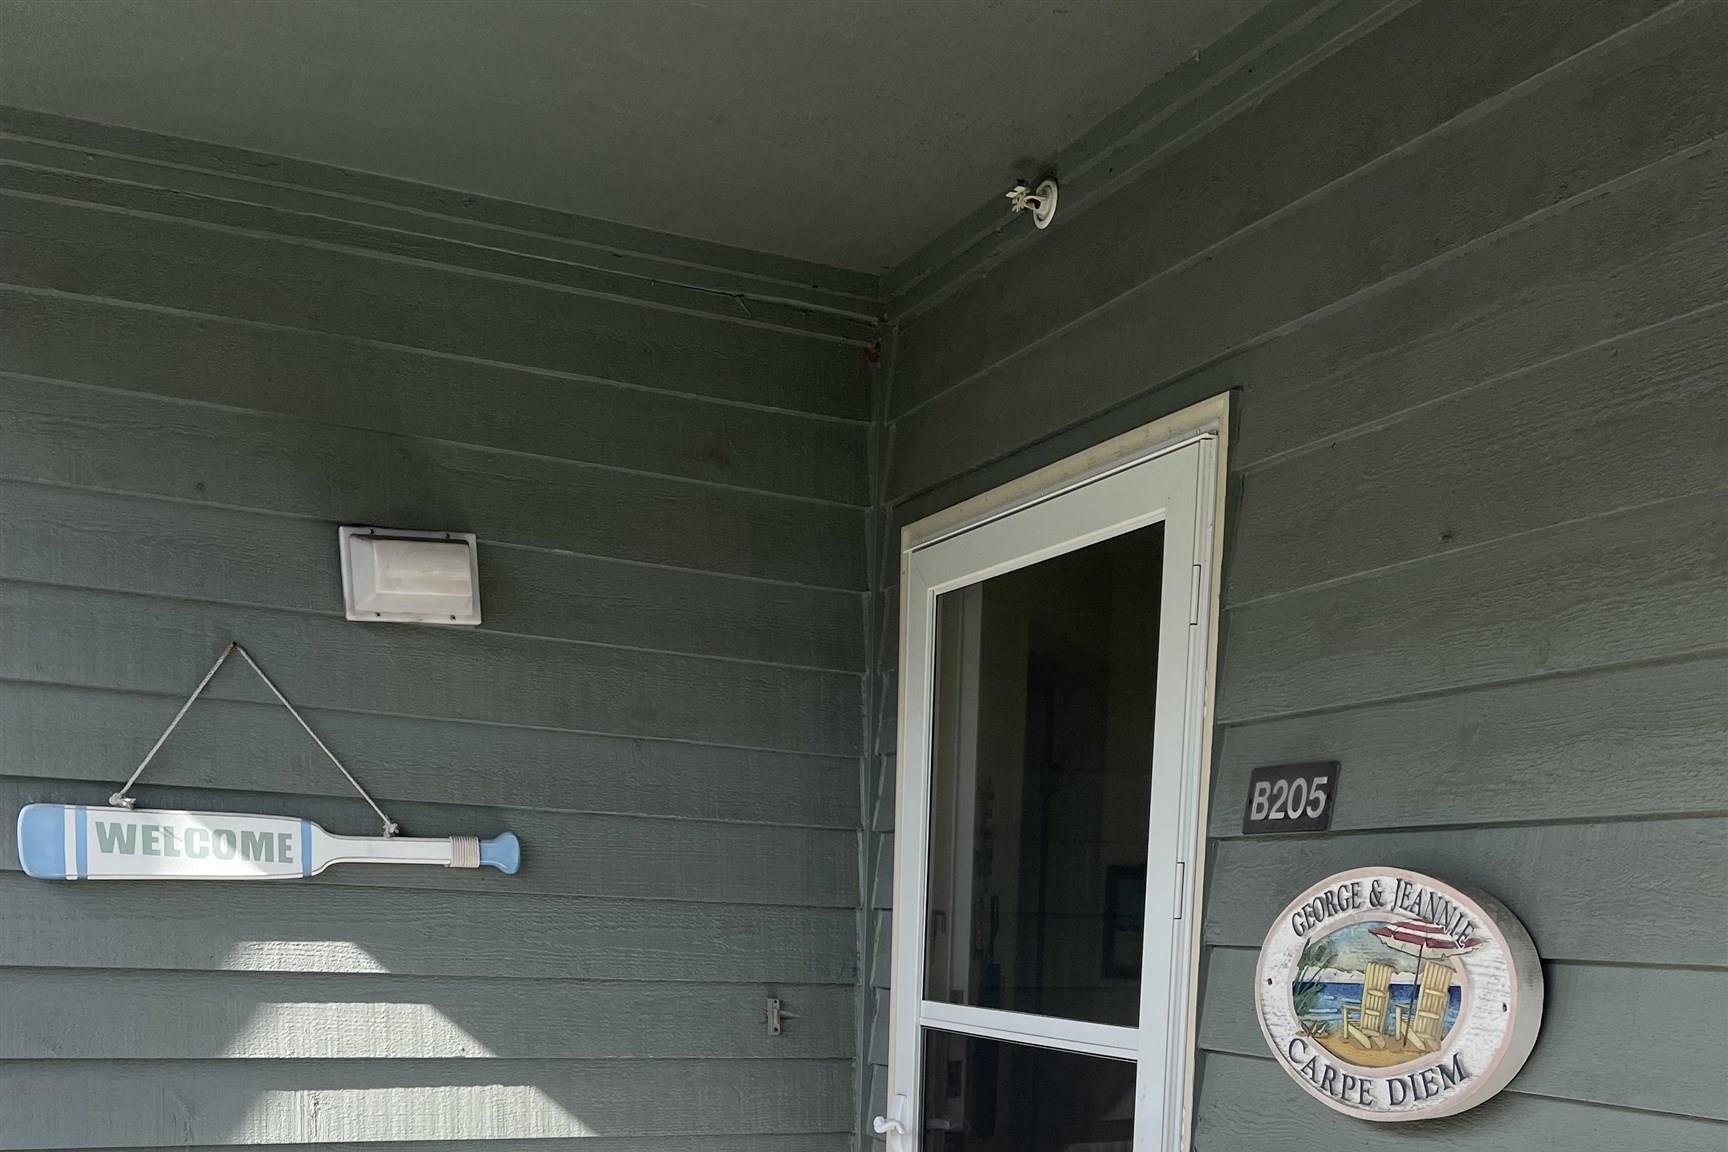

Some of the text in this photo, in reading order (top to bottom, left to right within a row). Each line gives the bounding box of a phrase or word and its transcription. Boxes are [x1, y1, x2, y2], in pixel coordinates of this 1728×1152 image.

[1250, 776, 1328, 820] B205
[95, 821, 294, 863] WELCOME
[1291, 877, 1476, 949] GEORGE & JEANNIE
[1288, 1037, 1470, 1106] CARPE DIEM
